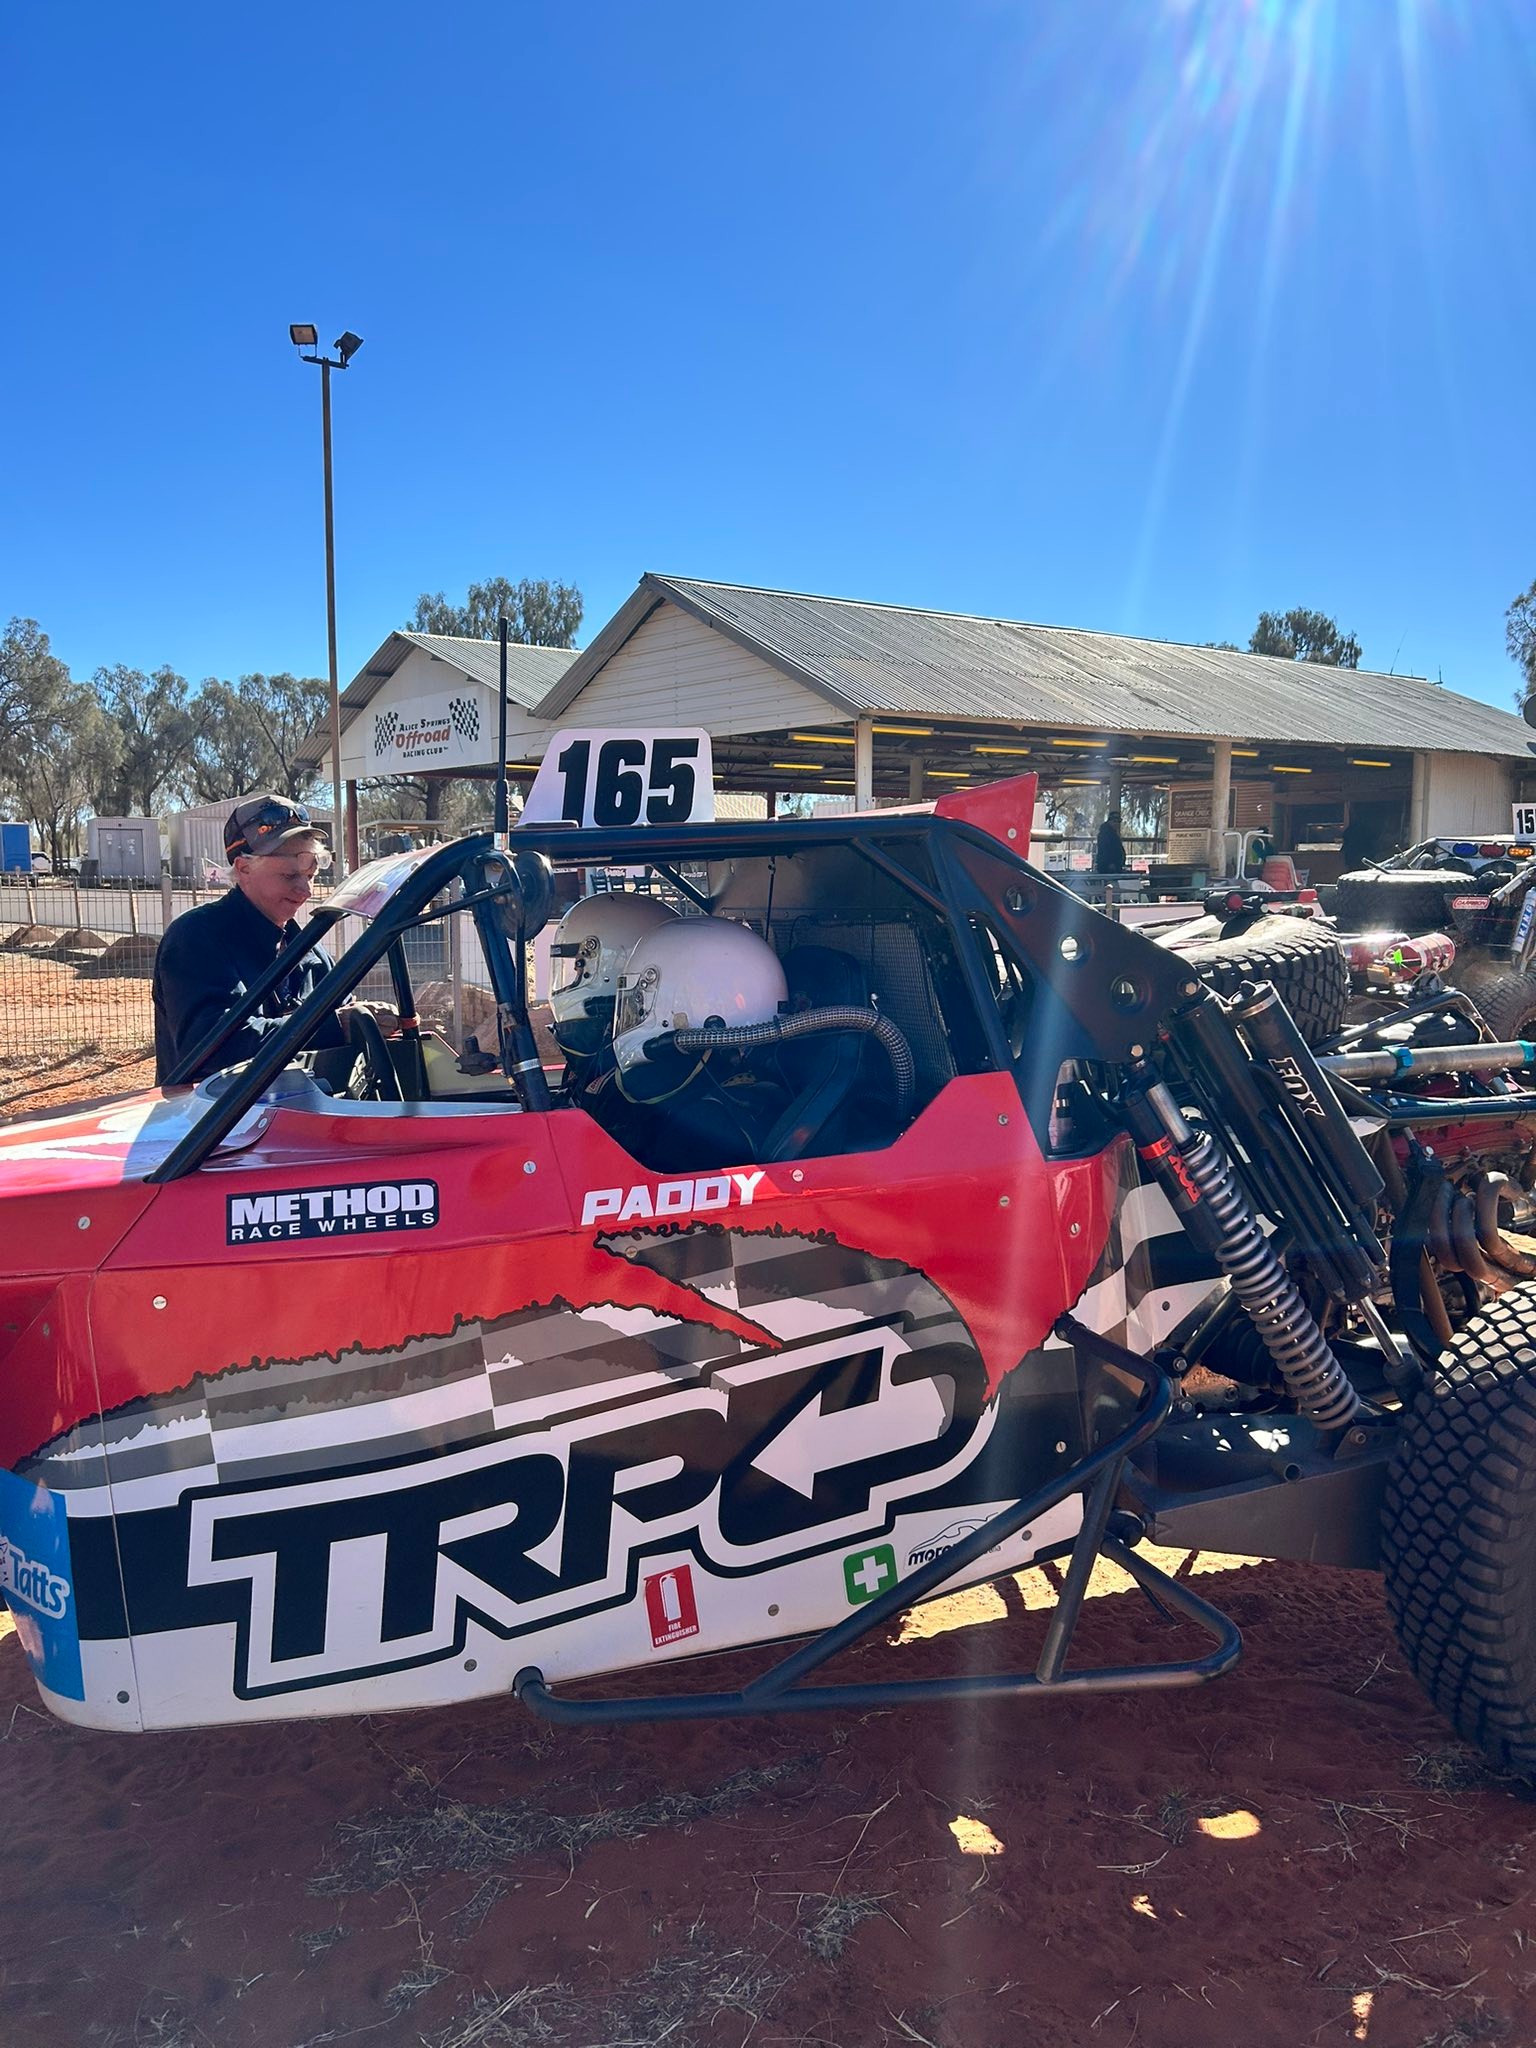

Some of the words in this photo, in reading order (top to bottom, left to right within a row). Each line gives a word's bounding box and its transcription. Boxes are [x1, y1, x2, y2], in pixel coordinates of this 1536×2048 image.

[396, 724, 451, 750] Offroad
[402, 749, 425, 758] RACING
[426, 746, 443, 756] CLUB
[558, 738, 699, 828] 165
[1268, 1056, 1326, 1117] FOX
[231, 1183, 434, 1226] METHOD
[580, 1170, 766, 1226] PADDY
[231, 1222, 300, 1241] RACE
[318, 1212, 434, 1232] WHEELS
[10, 1549, 63, 1612] Tatts
[654, 1625, 697, 1644] EXTINGUISHER
[668, 1621, 682, 1632] FIRE
